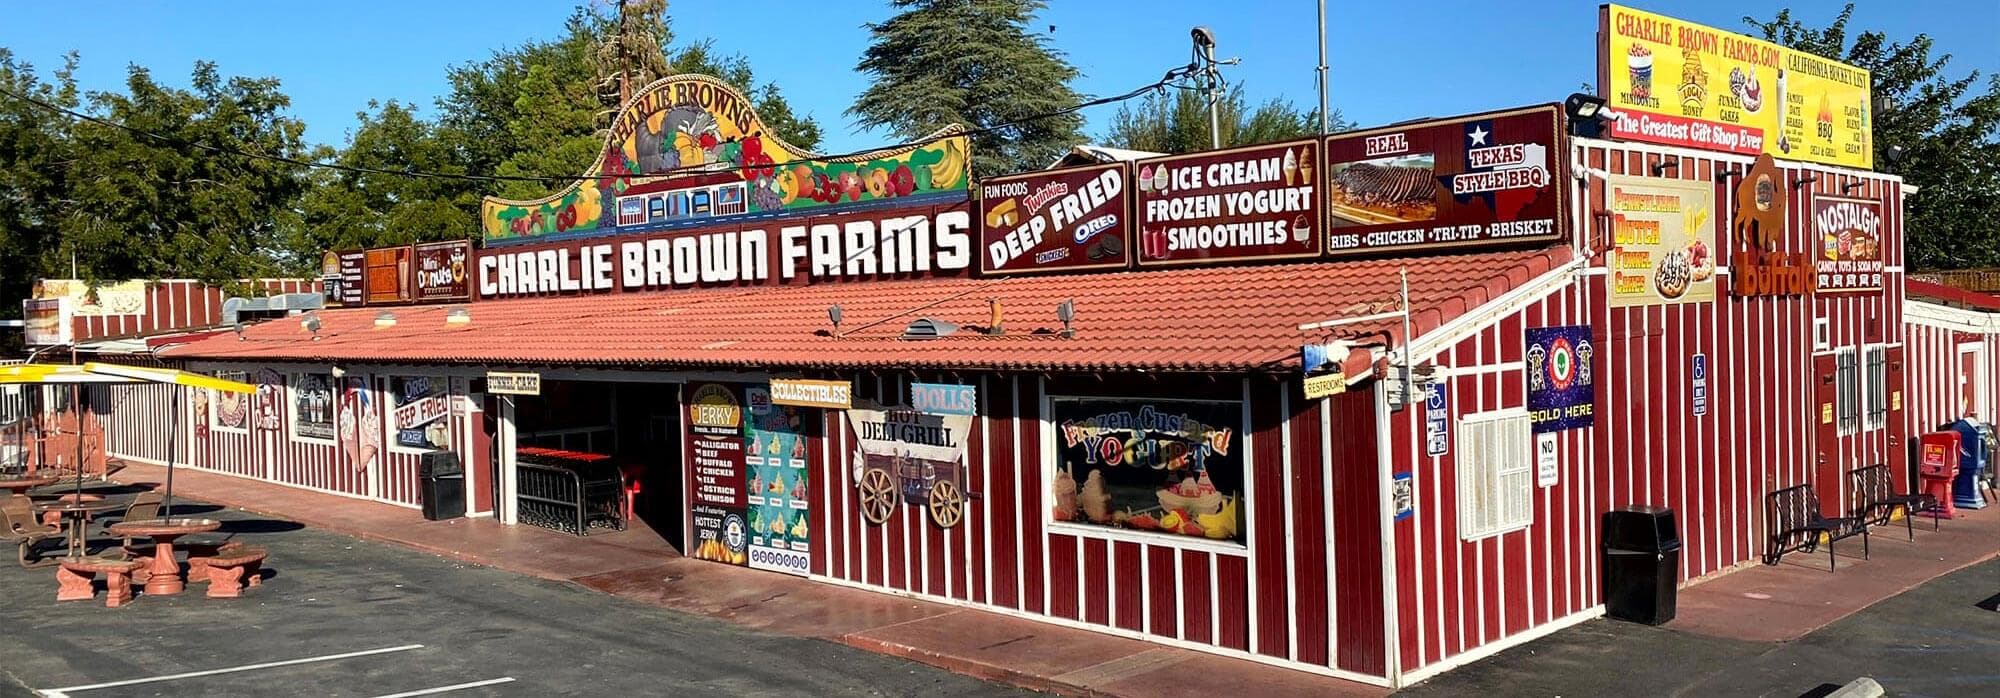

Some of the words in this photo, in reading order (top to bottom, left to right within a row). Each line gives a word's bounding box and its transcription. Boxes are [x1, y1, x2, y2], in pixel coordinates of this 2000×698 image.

[1616, 12, 1672, 46] CHARLIE
[1678, 26, 1718, 56] BROWN
[1723, 36, 1780, 70] FARMS.COM
[1788, 54, 1828, 79] CALIFORNIA
[1829, 65, 1852, 86] BUCKET
[1853, 72, 1866, 89] LIST
[1682, 88, 1702, 102] LOCAL
[1718, 94, 1741, 109] FUNNEL
[1683, 105, 1704, 118] HONEY
[1720, 110, 1739, 123] CAKES
[1789, 105, 1800, 116] DATE
[1615, 111, 1638, 133] The
[1640, 114, 1688, 140] Greatest
[1690, 122, 1712, 143] Gift
[1713, 127, 1738, 150] Shop
[1740, 129, 1762, 150] Ever
[1817, 122, 1833, 144] BBQ
[1366, 132, 1408, 156] REAL
[1469, 144, 1524, 168] TEXAS
[1171, 166, 1202, 191] ICE
[1206, 158, 1280, 186] CREAM
[1454, 168, 1506, 194] STYLE
[1507, 166, 1544, 188] BBQ
[985, 185, 1000, 199] FUN
[1001, 182, 1028, 196] FOODS
[1023, 181, 1068, 215] Twinkies
[1146, 194, 1220, 223] FROZEN
[1225, 186, 1313, 216] YOGURT
[988, 215, 1046, 270] DEEP
[1049, 168, 1122, 233] FRIED
[1074, 214, 1117, 244] OREO
[1615, 214, 1660, 245] DUTCH
[1817, 202, 1880, 242] NOSTALGIC
[1168, 220, 1288, 251] SMOOTHIES
[1331, 234, 1359, 249] RIBS
[1367, 229, 1424, 246] CHICKEN
[1491, 219, 1553, 238] BRISKET
[423, 257, 437, 270] Mini
[479, 244, 613, 296] CHARLIE
[622, 230, 769, 288] BROWN
[782, 212, 970, 278] FARMS
[1039, 249, 1064, 263] SNICKERS
[1615, 247, 1652, 269] FUNNEL
[1741, 251, 1815, 296] buffalo
[1838, 260, 1851, 272] TOYS
[1852, 261, 1857, 272] &
[1857, 261, 1872, 272] SODA
[1872, 261, 1882, 272] POP
[418, 267, 452, 288] Donuts
[1615, 271, 1645, 294] CAKES
[404, 377, 428, 398] OREO
[772, 383, 848, 404] COLLECTIBLES
[1307, 377, 1344, 392] RESTROOMS
[915, 388, 970, 411] DOLLS
[394, 406, 416, 430] DEEP
[421, 394, 448, 421] FRIED
[697, 406, 732, 424] JERKY
[888, 411, 922, 425] HOT
[1530, 410, 1560, 423] SOLD
[1565, 404, 1592, 417] HERE
[862, 421, 898, 441] DELI
[901, 422, 956, 448] GRILL
[1061, 411, 1131, 448] Frozen
[1139, 405, 1232, 456] Custard
[702, 442, 739, 451] ALLIGATOR
[702, 450, 718, 458] BEEF
[1083, 436, 1211, 470] YOGURT
[1542, 440, 1553, 454] NO
[702, 458, 732, 467] BUFFALO
[703, 468, 734, 477] CHICKEN
[704, 477, 715, 485] ELK
[704, 486, 735, 495] OSTRICH
[704, 494, 735, 504] VENISON
[695, 516, 721, 529] HOTTEST
[700, 529, 717, 540] JERKY
